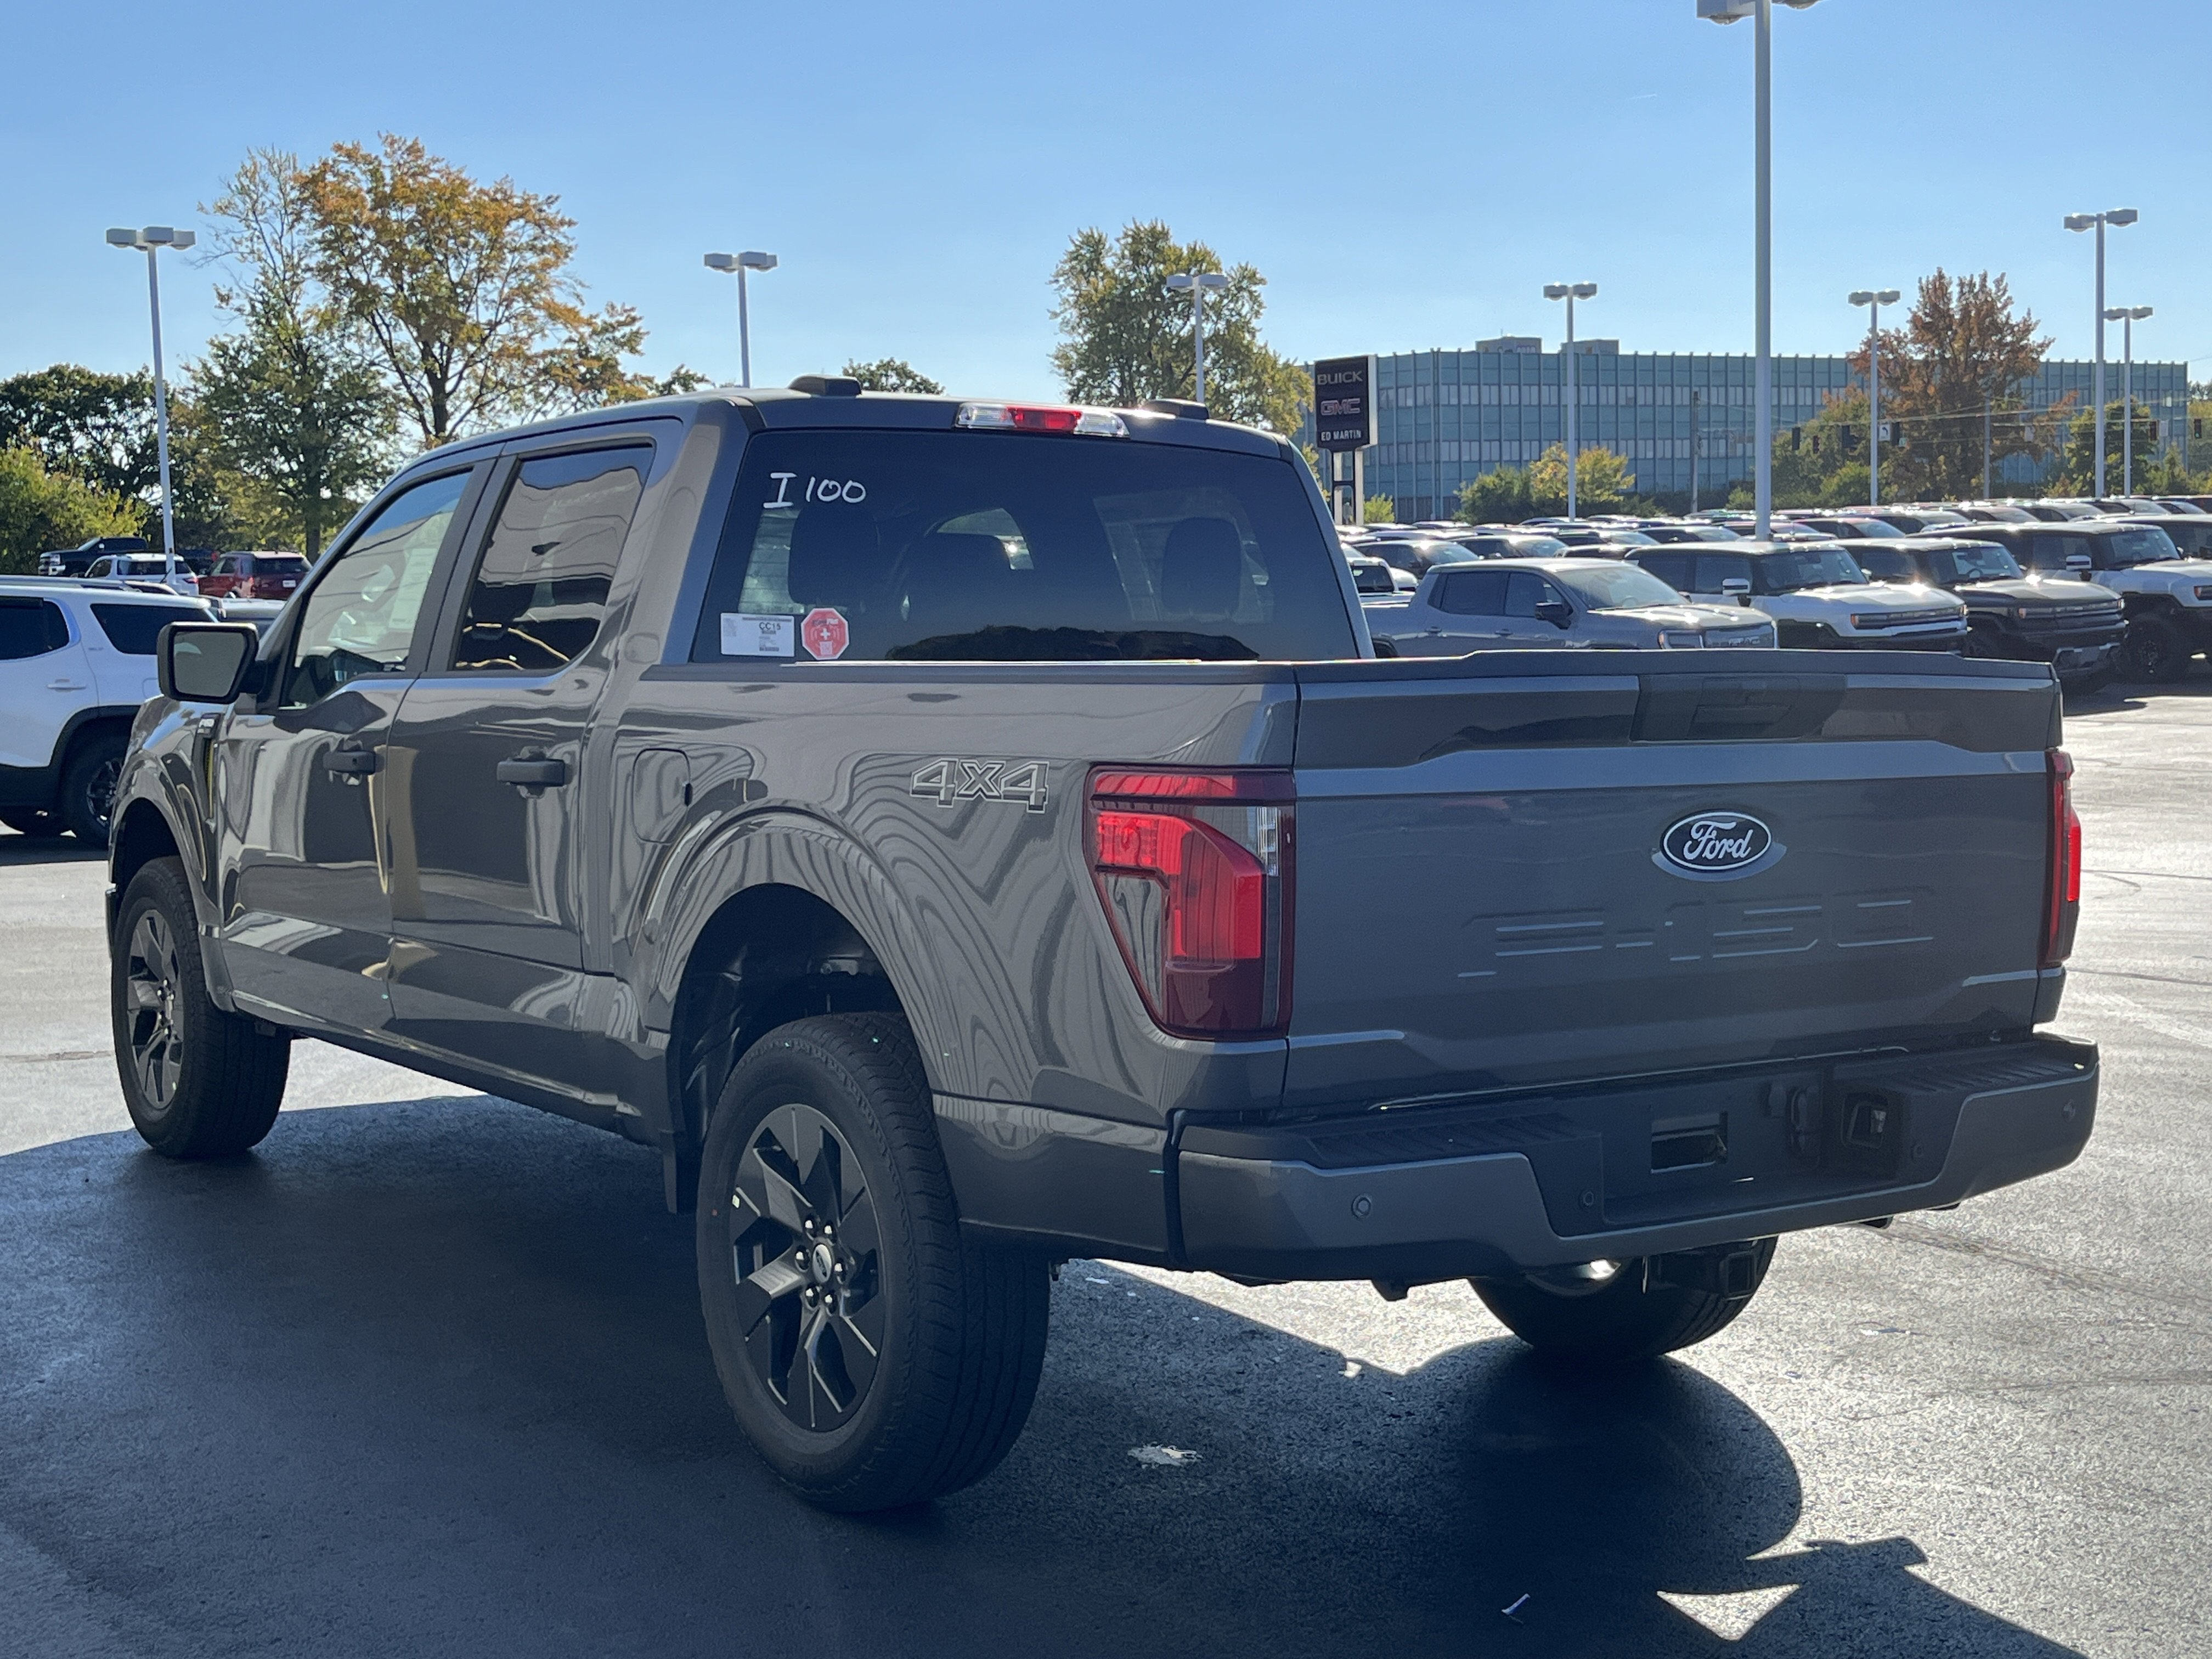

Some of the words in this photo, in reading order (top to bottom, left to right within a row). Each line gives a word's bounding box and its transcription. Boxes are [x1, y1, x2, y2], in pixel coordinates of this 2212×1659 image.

[1317, 371, 1363, 385] BUICK
[1321, 398, 1361, 416] GMC
[1321, 431, 1331, 441] ED
[1333, 430, 1361, 440] MARTIN
[759, 622, 781, 630] CC15
[1683, 821, 1754, 860] Ford
